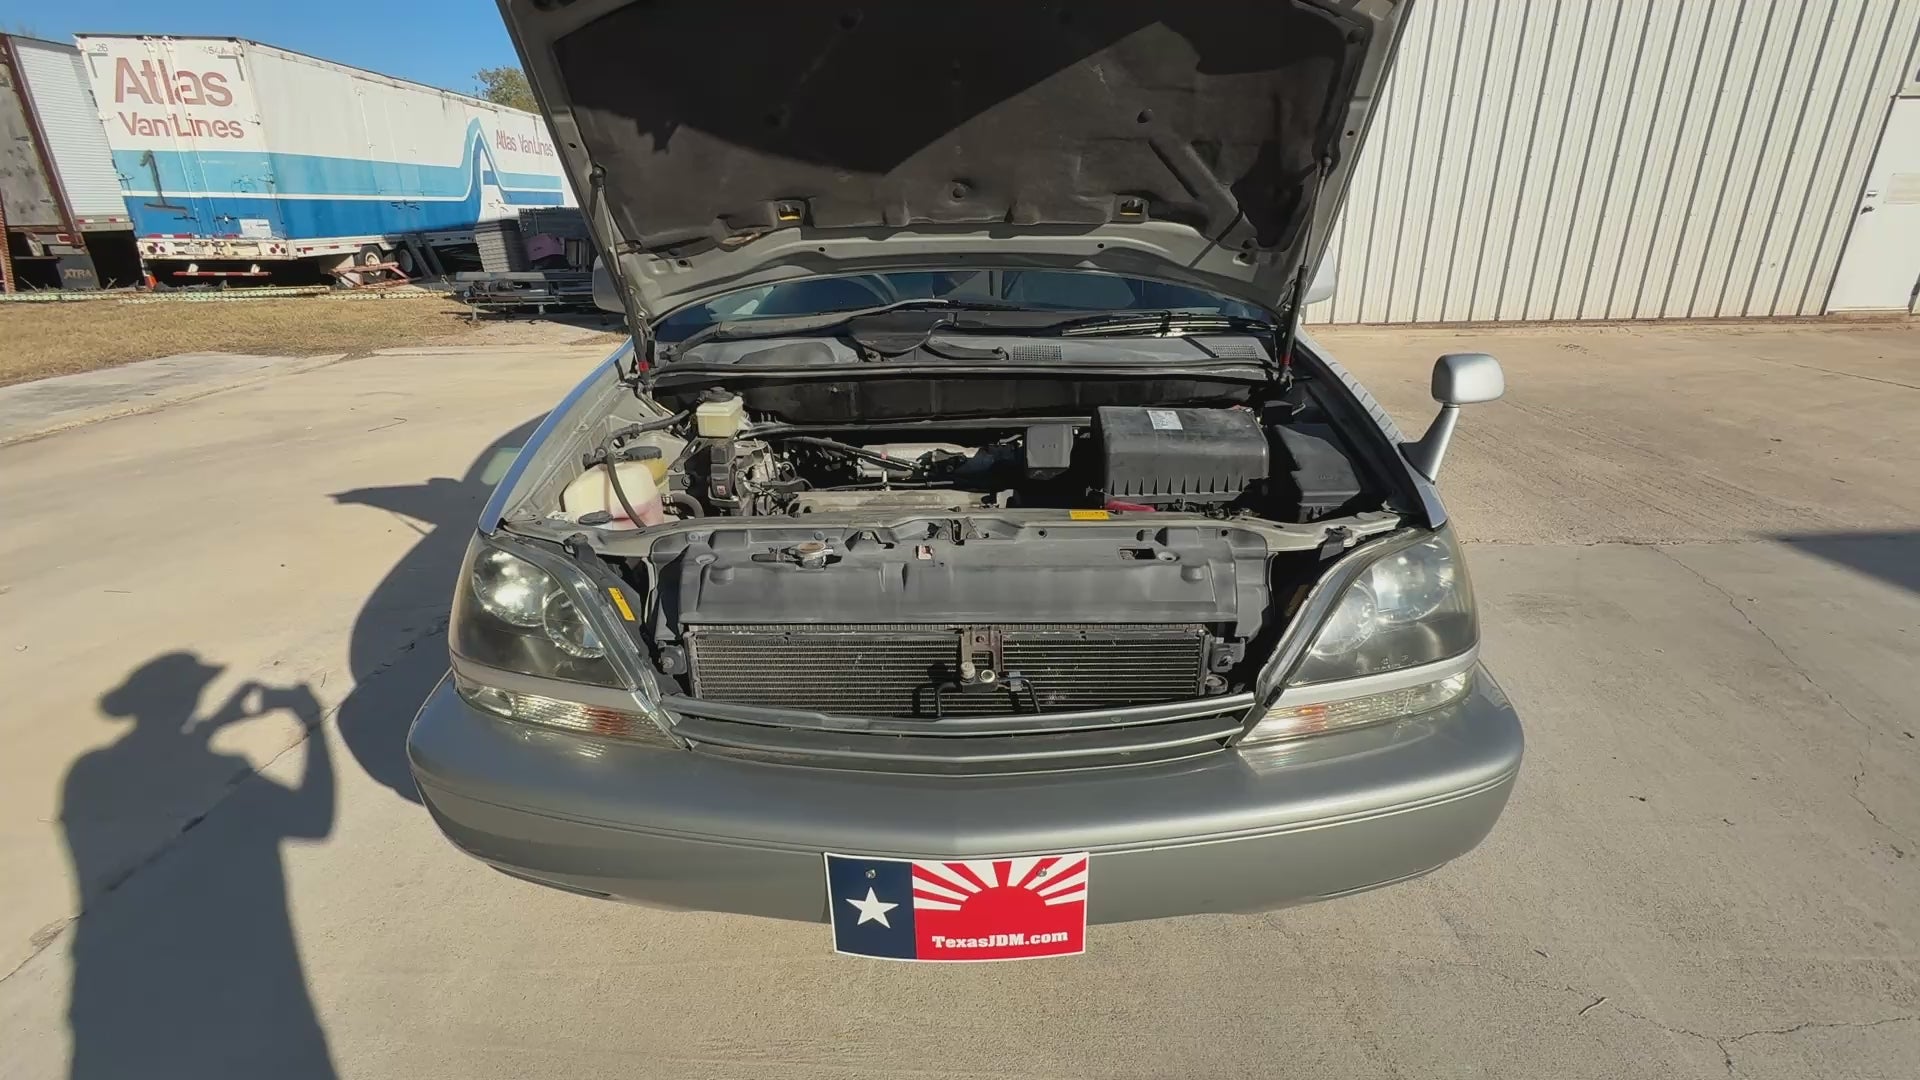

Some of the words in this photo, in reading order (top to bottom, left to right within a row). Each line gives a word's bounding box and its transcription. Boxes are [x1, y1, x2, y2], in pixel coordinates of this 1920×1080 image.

[115, 57, 232, 107] Atlas
[118, 111, 171, 137] Van
[172, 113, 245, 139] Lines
[496, 129, 517, 151] Atlas
[63, 268, 93, 279] XTRA
[932, 931, 1068, 948] TexasJDM.com
